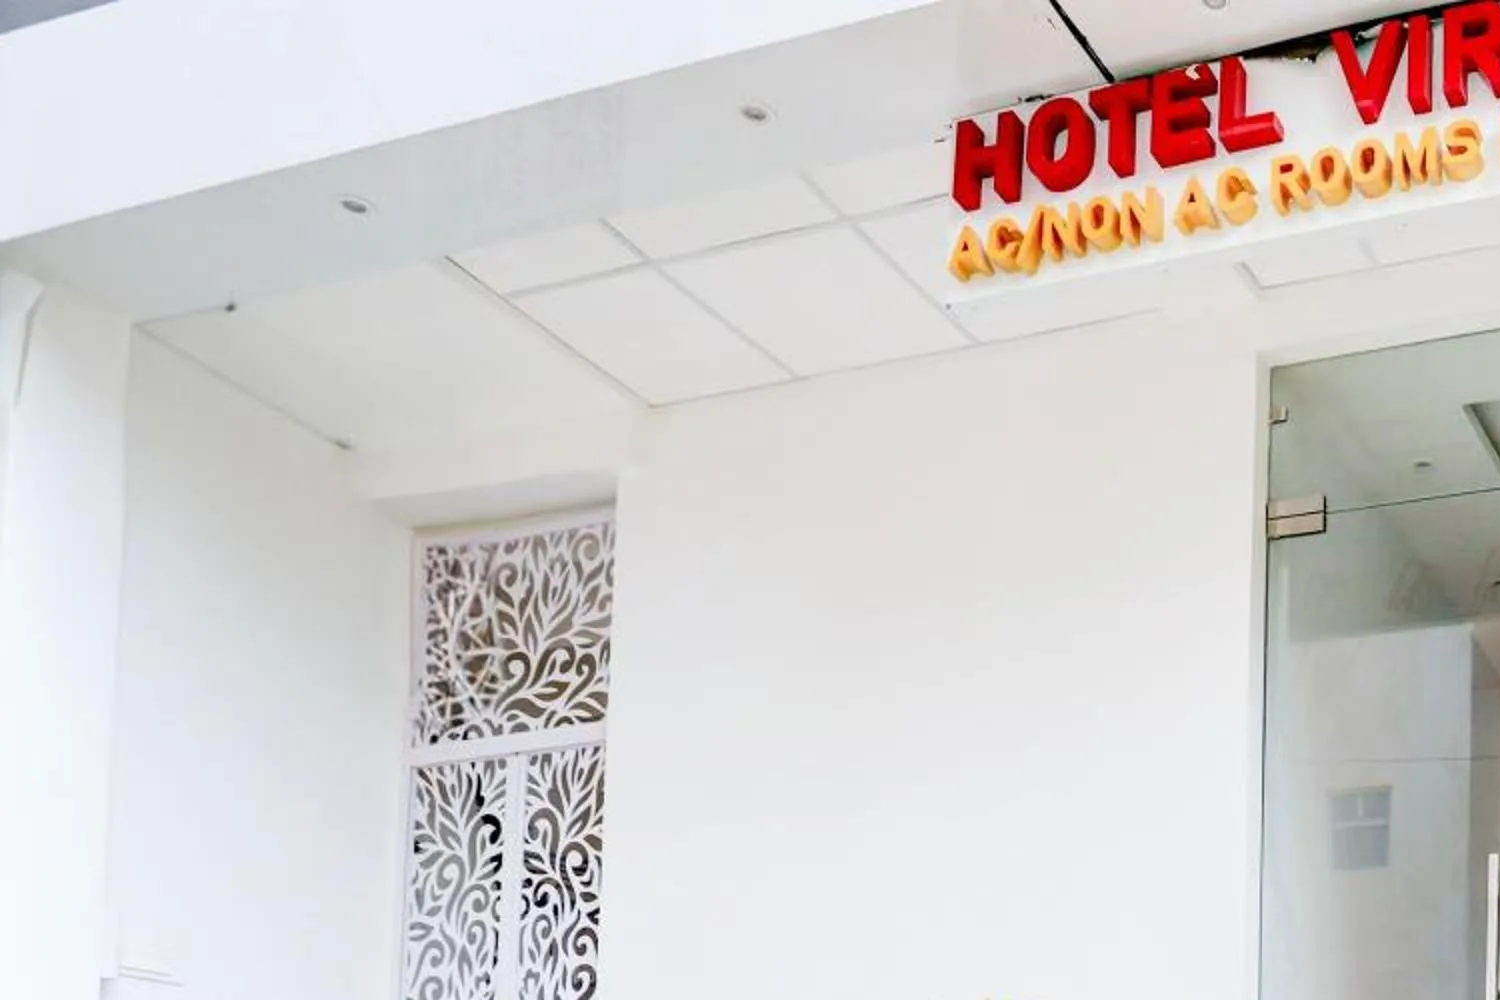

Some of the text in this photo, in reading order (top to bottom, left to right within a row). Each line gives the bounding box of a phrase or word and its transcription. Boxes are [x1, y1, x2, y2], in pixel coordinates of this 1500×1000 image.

[947, 184, 1166, 283] AC/NON
[1173, 172, 1260, 237] AC
[1269, 118, 1485, 219] ROOMS
[953, 55, 1284, 212] HOTEL
